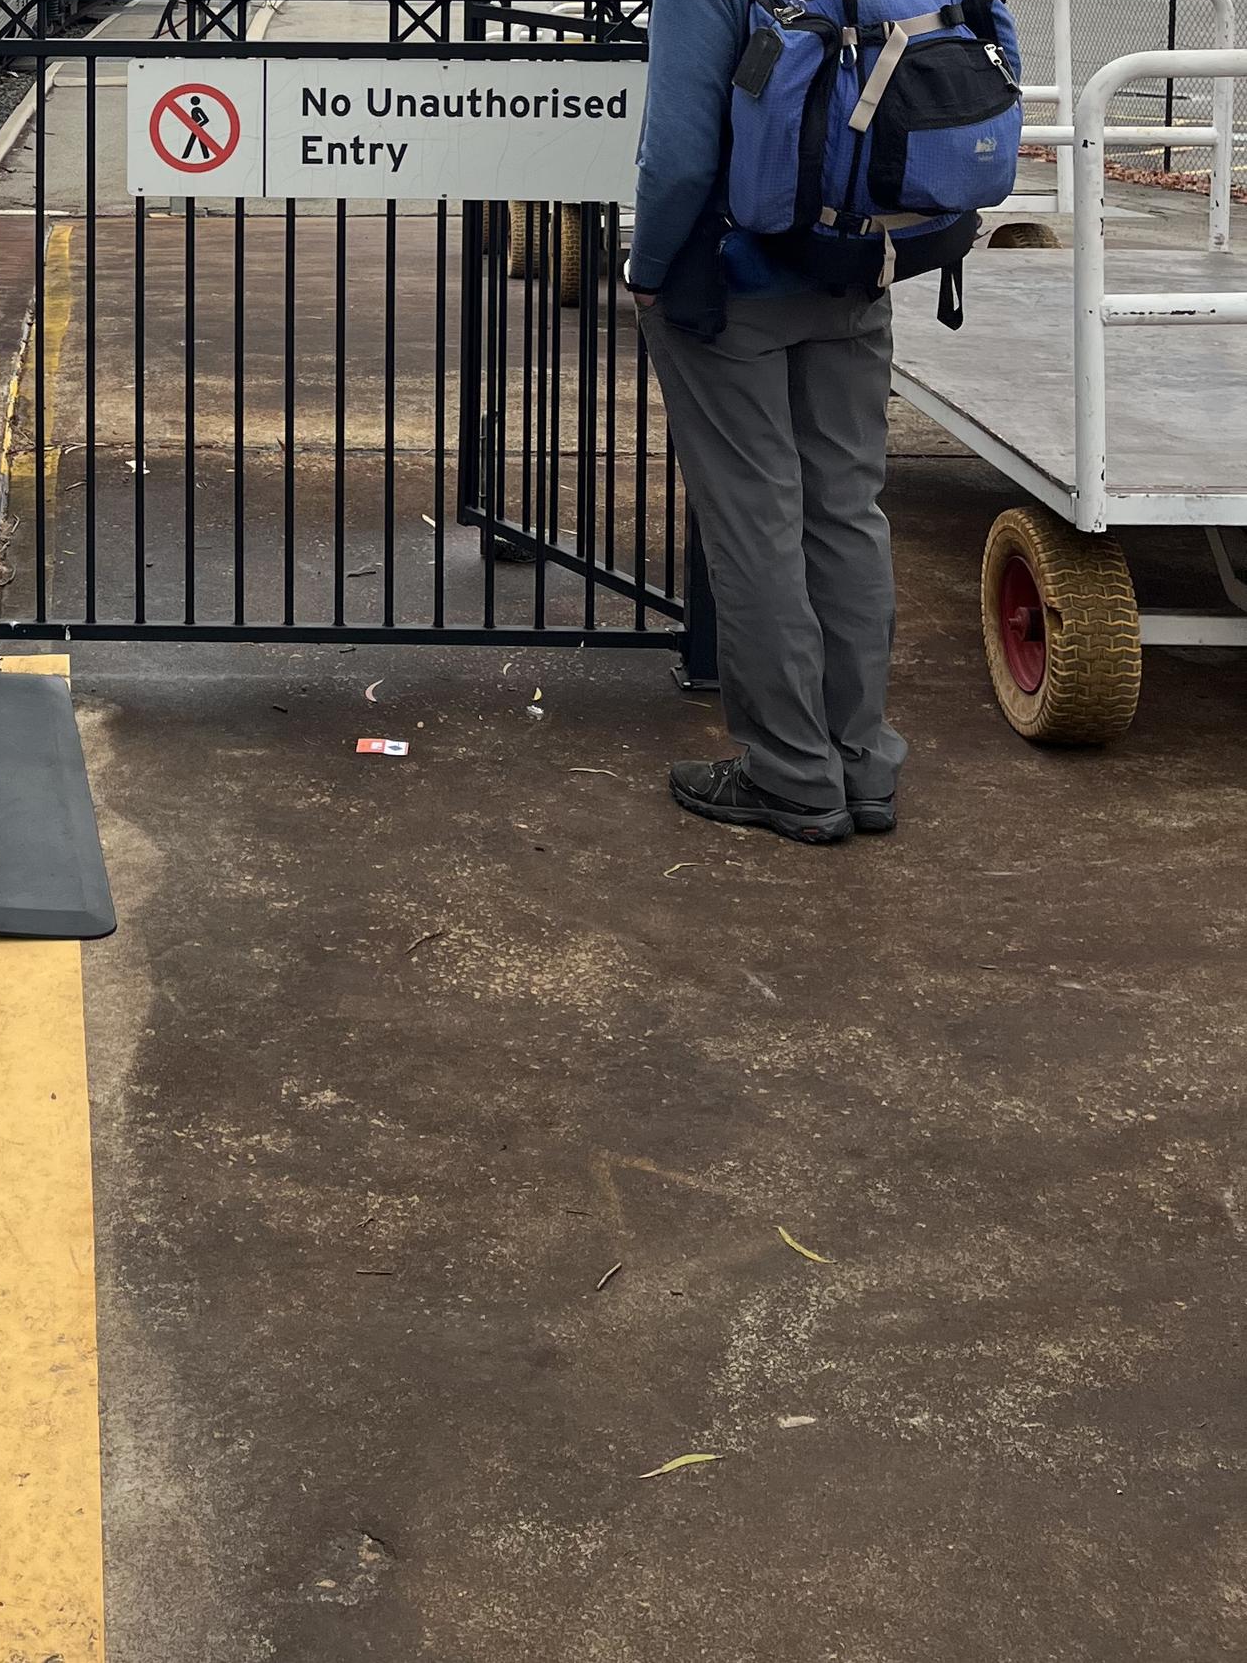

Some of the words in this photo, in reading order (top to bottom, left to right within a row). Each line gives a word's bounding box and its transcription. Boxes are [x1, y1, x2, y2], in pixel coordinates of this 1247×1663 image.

[302, 87, 351, 117] No
[367, 87, 628, 119] Unauthorised
[301, 134, 409, 173] Entry
